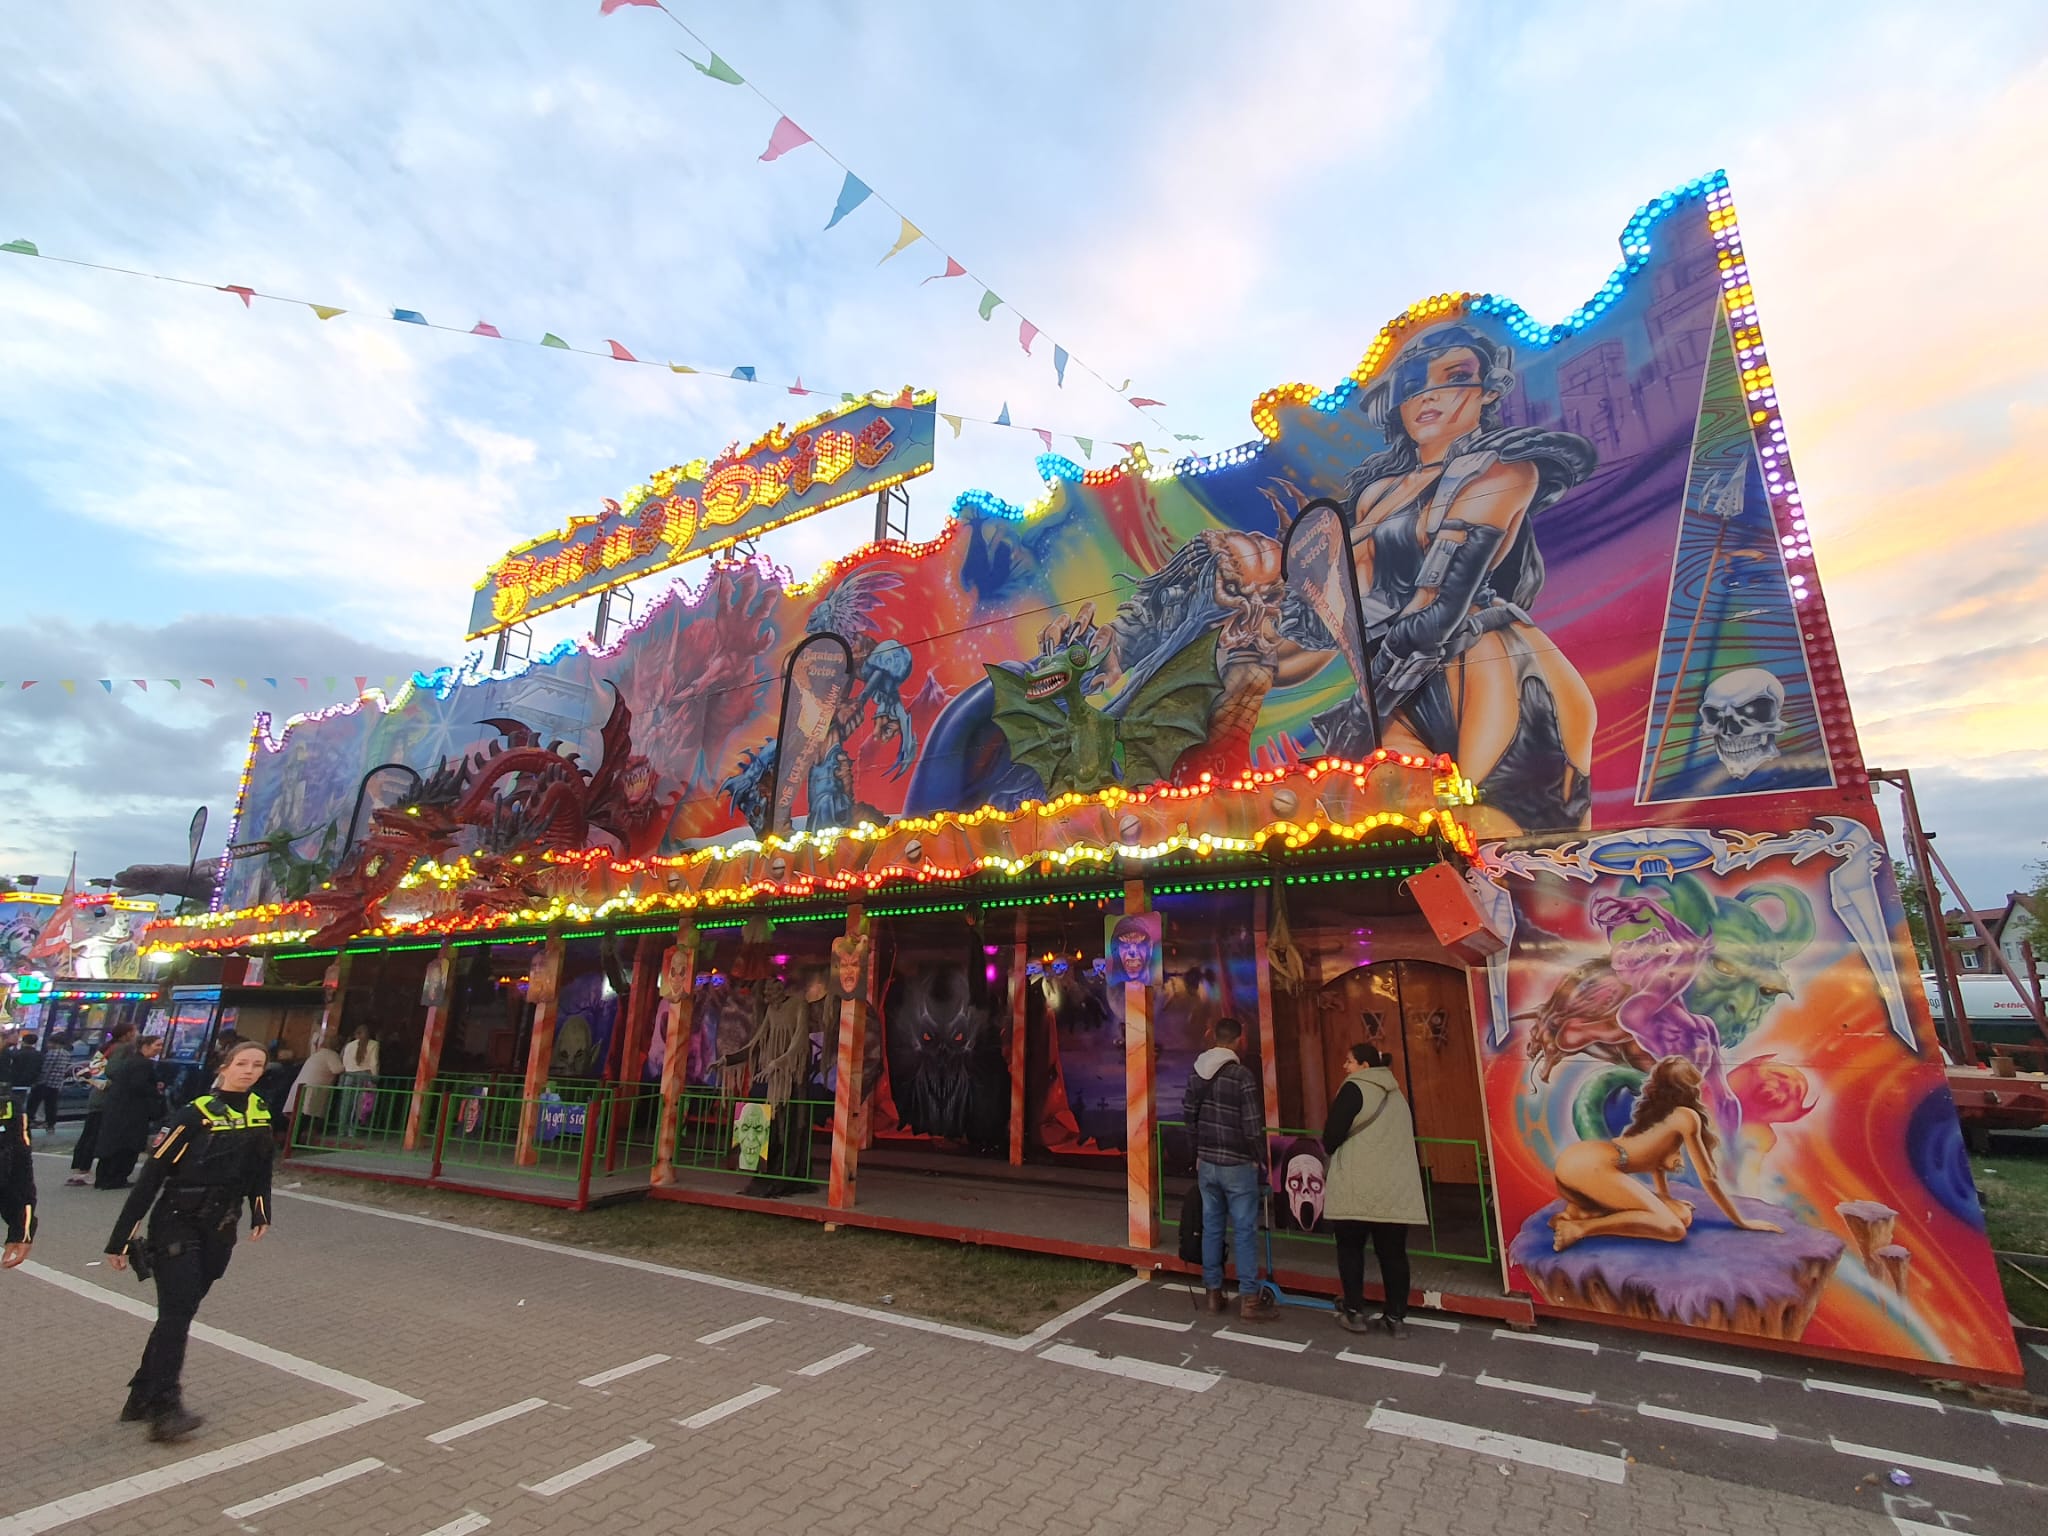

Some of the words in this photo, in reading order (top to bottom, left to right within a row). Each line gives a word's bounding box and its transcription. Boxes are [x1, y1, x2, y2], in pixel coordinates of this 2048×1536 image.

[492, 495, 698, 621] Fantasy
[700, 416, 895, 531] Drive
[803, 647, 844, 664] Fantasy
[808, 665, 837, 677] Drive
[779, 785, 794, 807] DIE
[1993, 1001, 2026, 1009] Dethle
